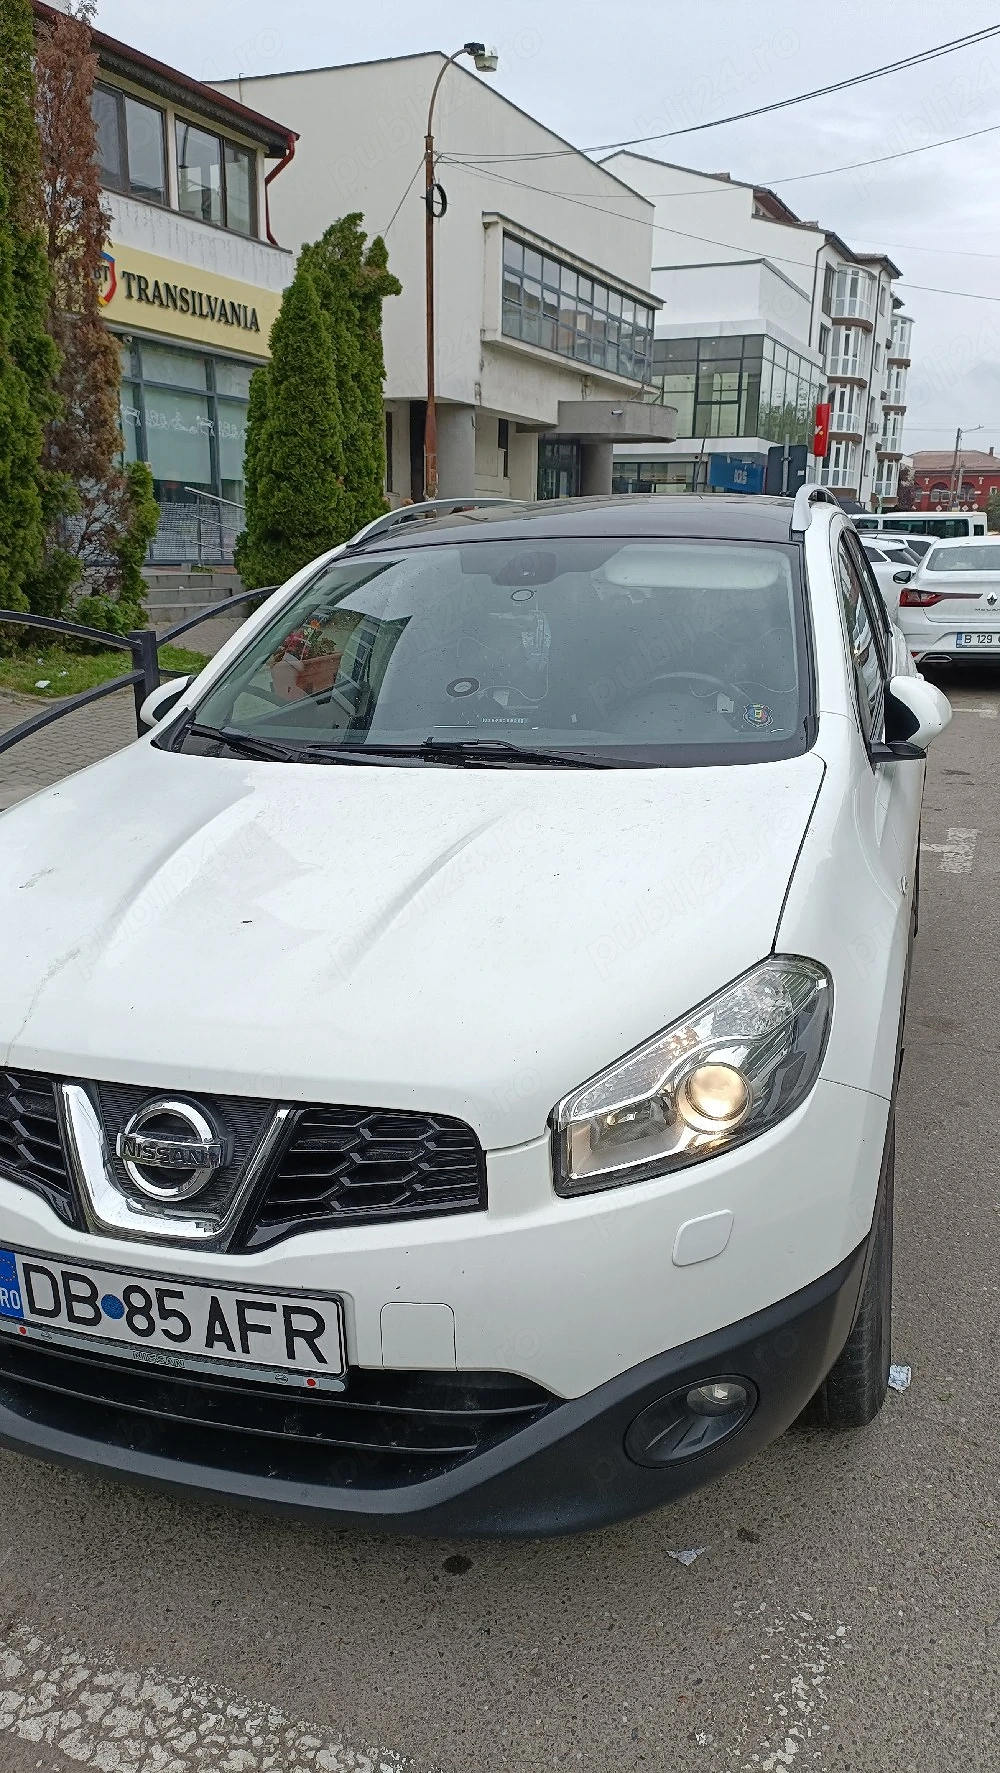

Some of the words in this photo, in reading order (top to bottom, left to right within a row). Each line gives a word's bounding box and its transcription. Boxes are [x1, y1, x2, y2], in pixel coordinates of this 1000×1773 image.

[121, 270, 261, 332] TRANSILVANIA
[964, 634, 972, 644] B
[977, 634, 993, 644] 129
[123, 1137, 205, 1166] NISSAN
[22, 1262, 102, 1327] DB
[122, 1284, 192, 1343] 85
[204, 1295, 328, 1365] AFR
